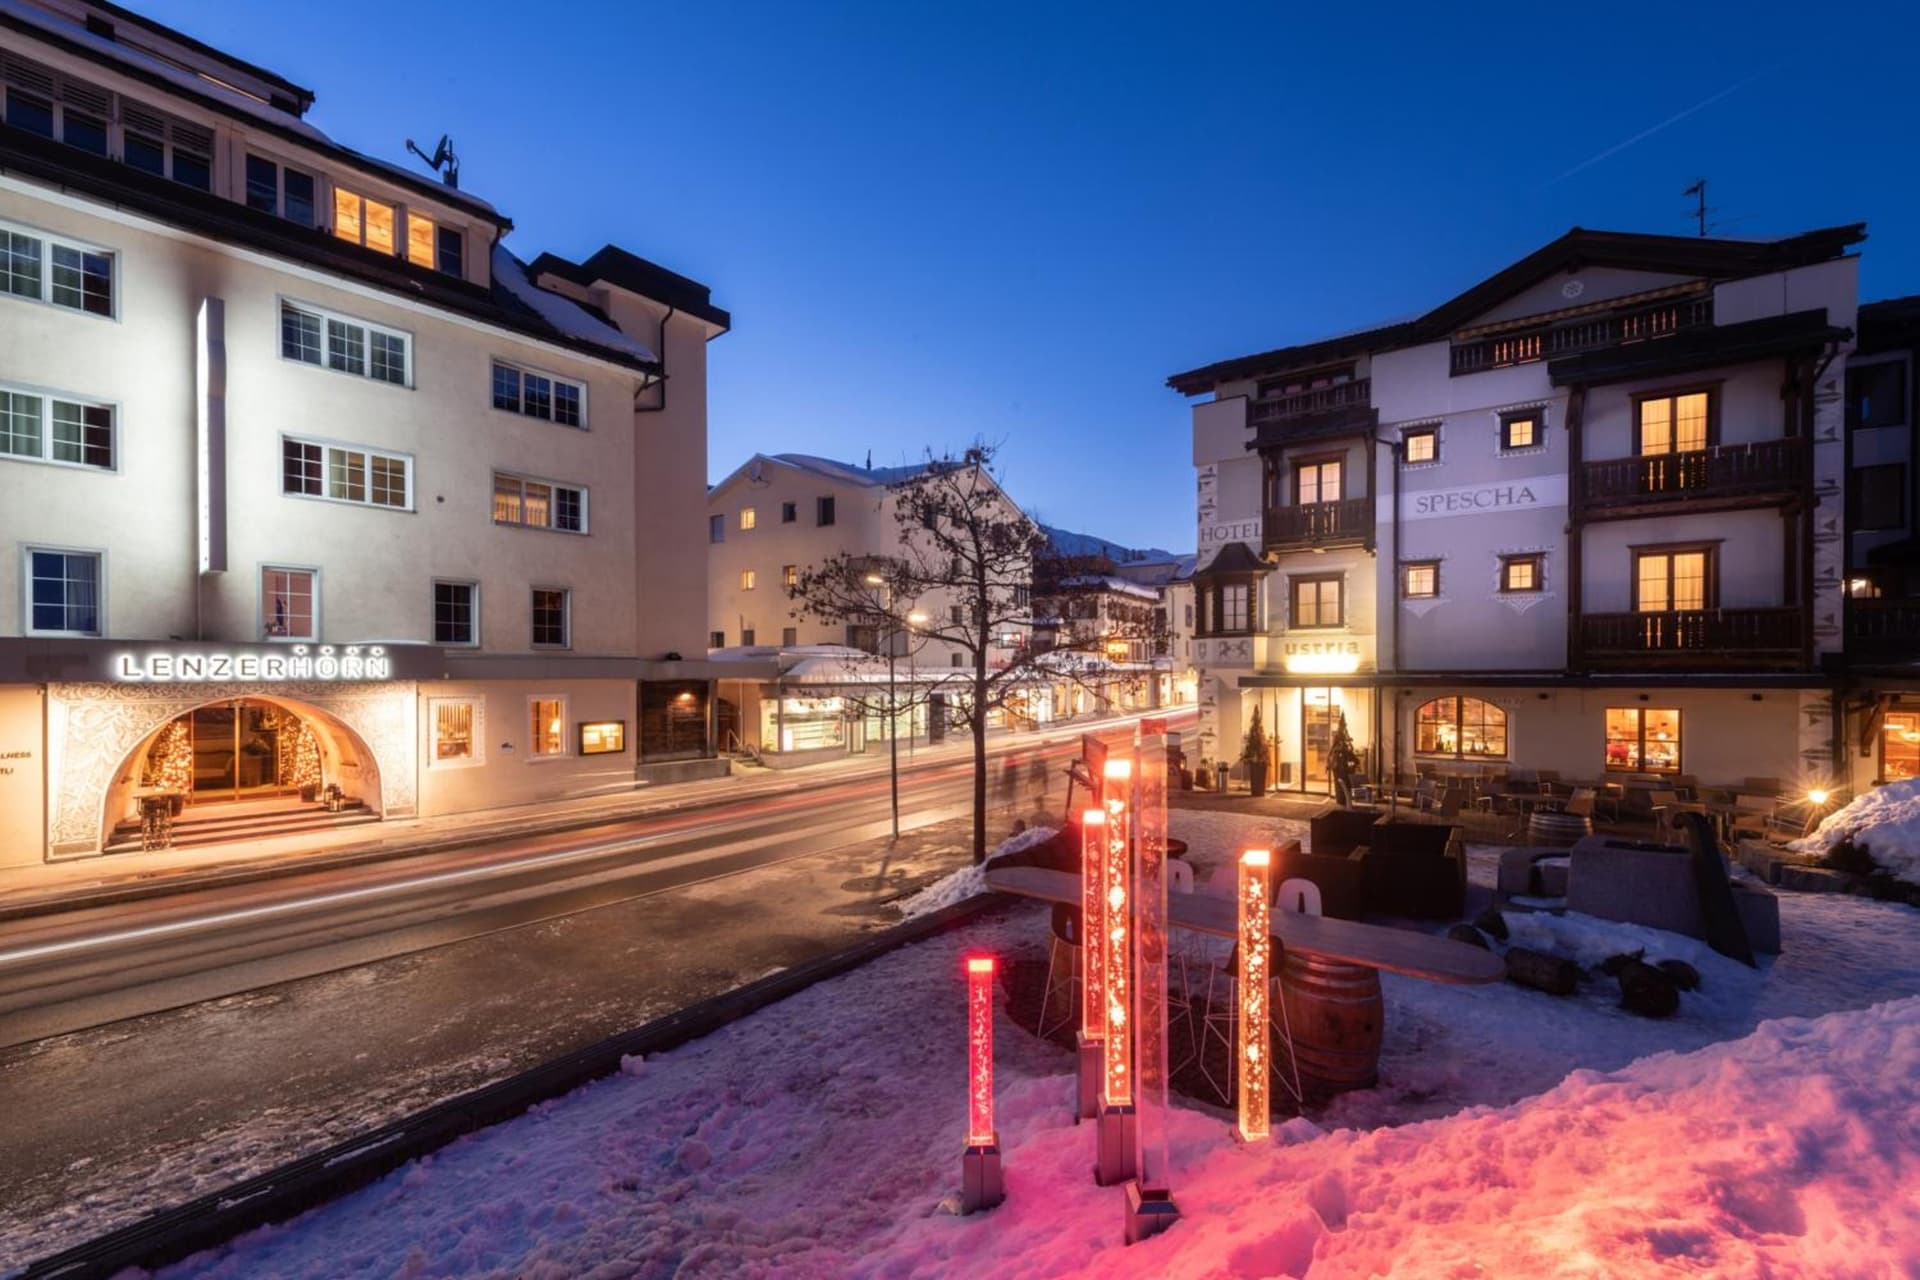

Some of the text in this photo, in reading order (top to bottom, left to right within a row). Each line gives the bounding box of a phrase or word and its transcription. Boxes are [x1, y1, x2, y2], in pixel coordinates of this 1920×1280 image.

[1416, 486, 1537, 514] SPESCHA
[1285, 640, 1360, 656] ustria
[116, 656, 389, 679] LENZERHORN
